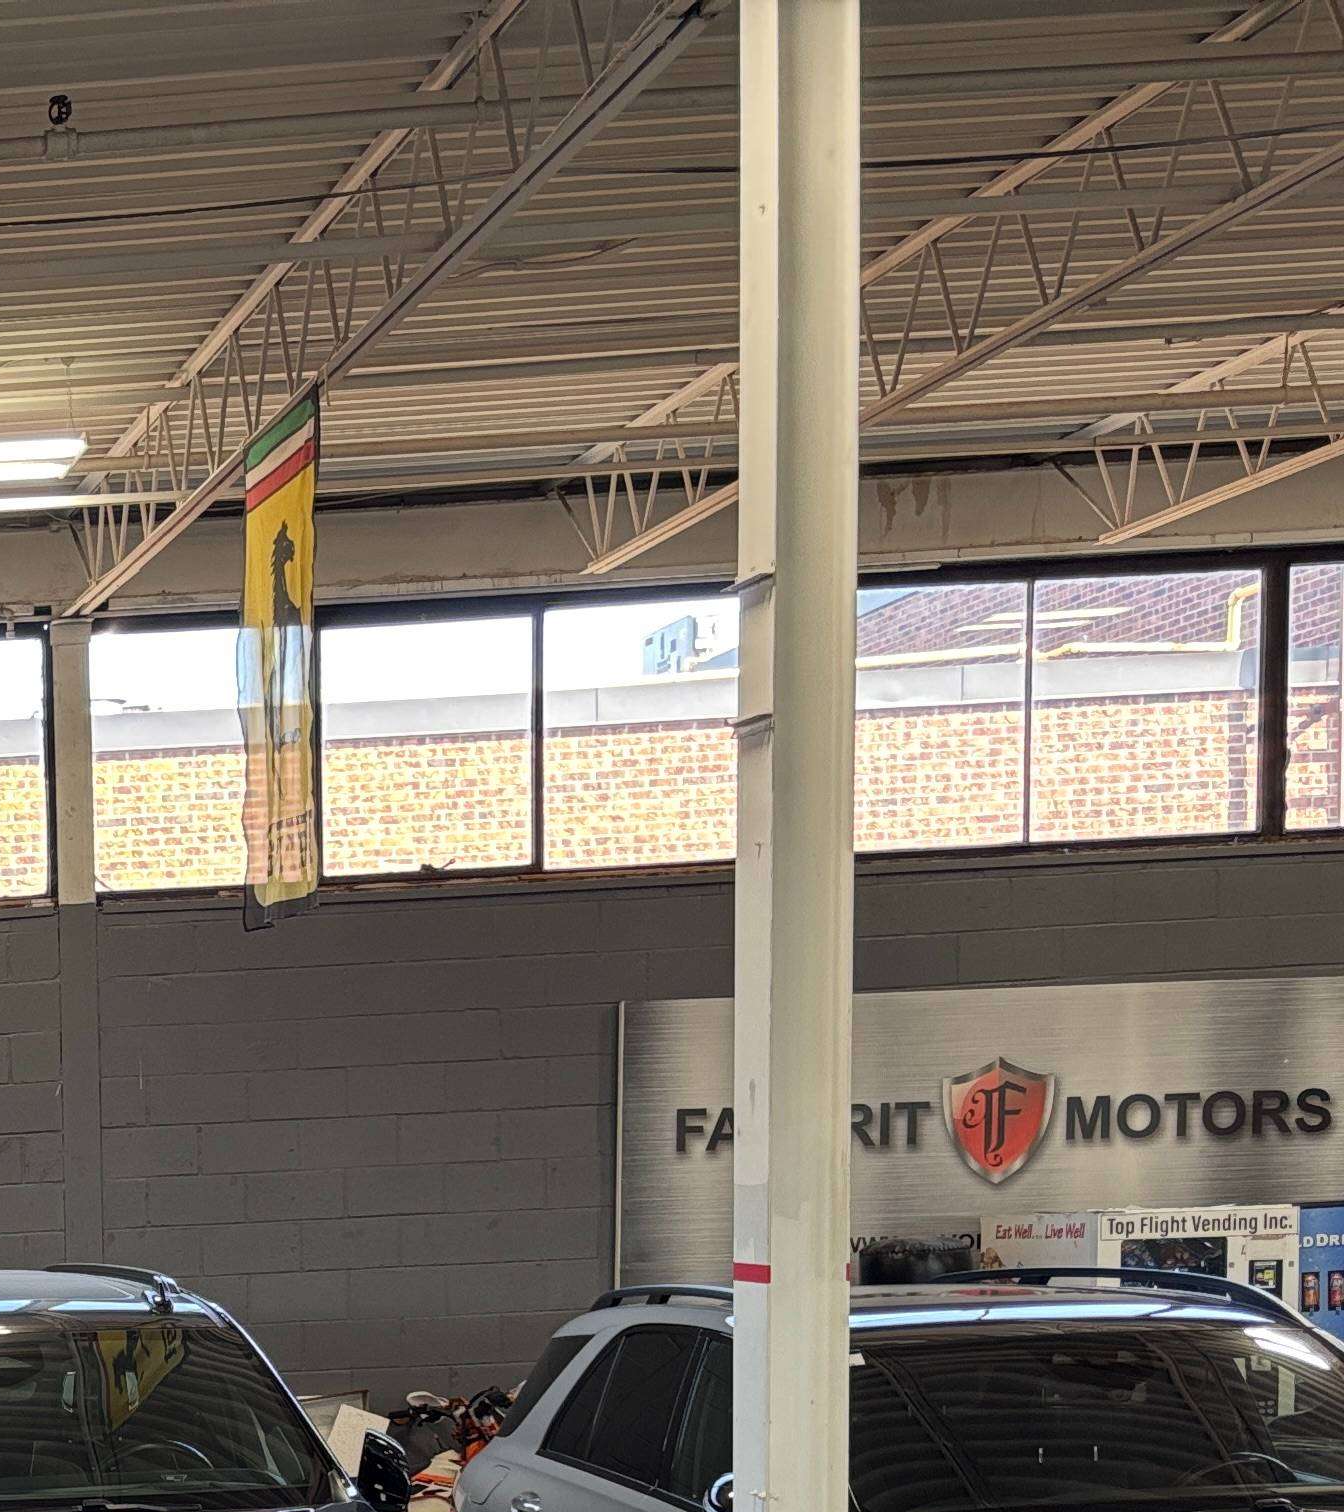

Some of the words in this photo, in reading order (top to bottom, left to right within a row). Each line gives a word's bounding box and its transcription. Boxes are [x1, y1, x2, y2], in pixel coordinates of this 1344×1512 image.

[676, 1101, 931, 1153] FARIT
[1065, 1088, 1332, 1142] MOTORS
[995, 1224, 1013, 1240] Eat
[1044, 1223, 1064, 1240] Live
[1066, 1222, 1086, 1240] Well
[1107, 1217, 1135, 1238] Top
[1140, 1215, 1187, 1237] Flight
[1192, 1213, 1258, 1234] Vending
[1263, 1212, 1293, 1231] Inc.
